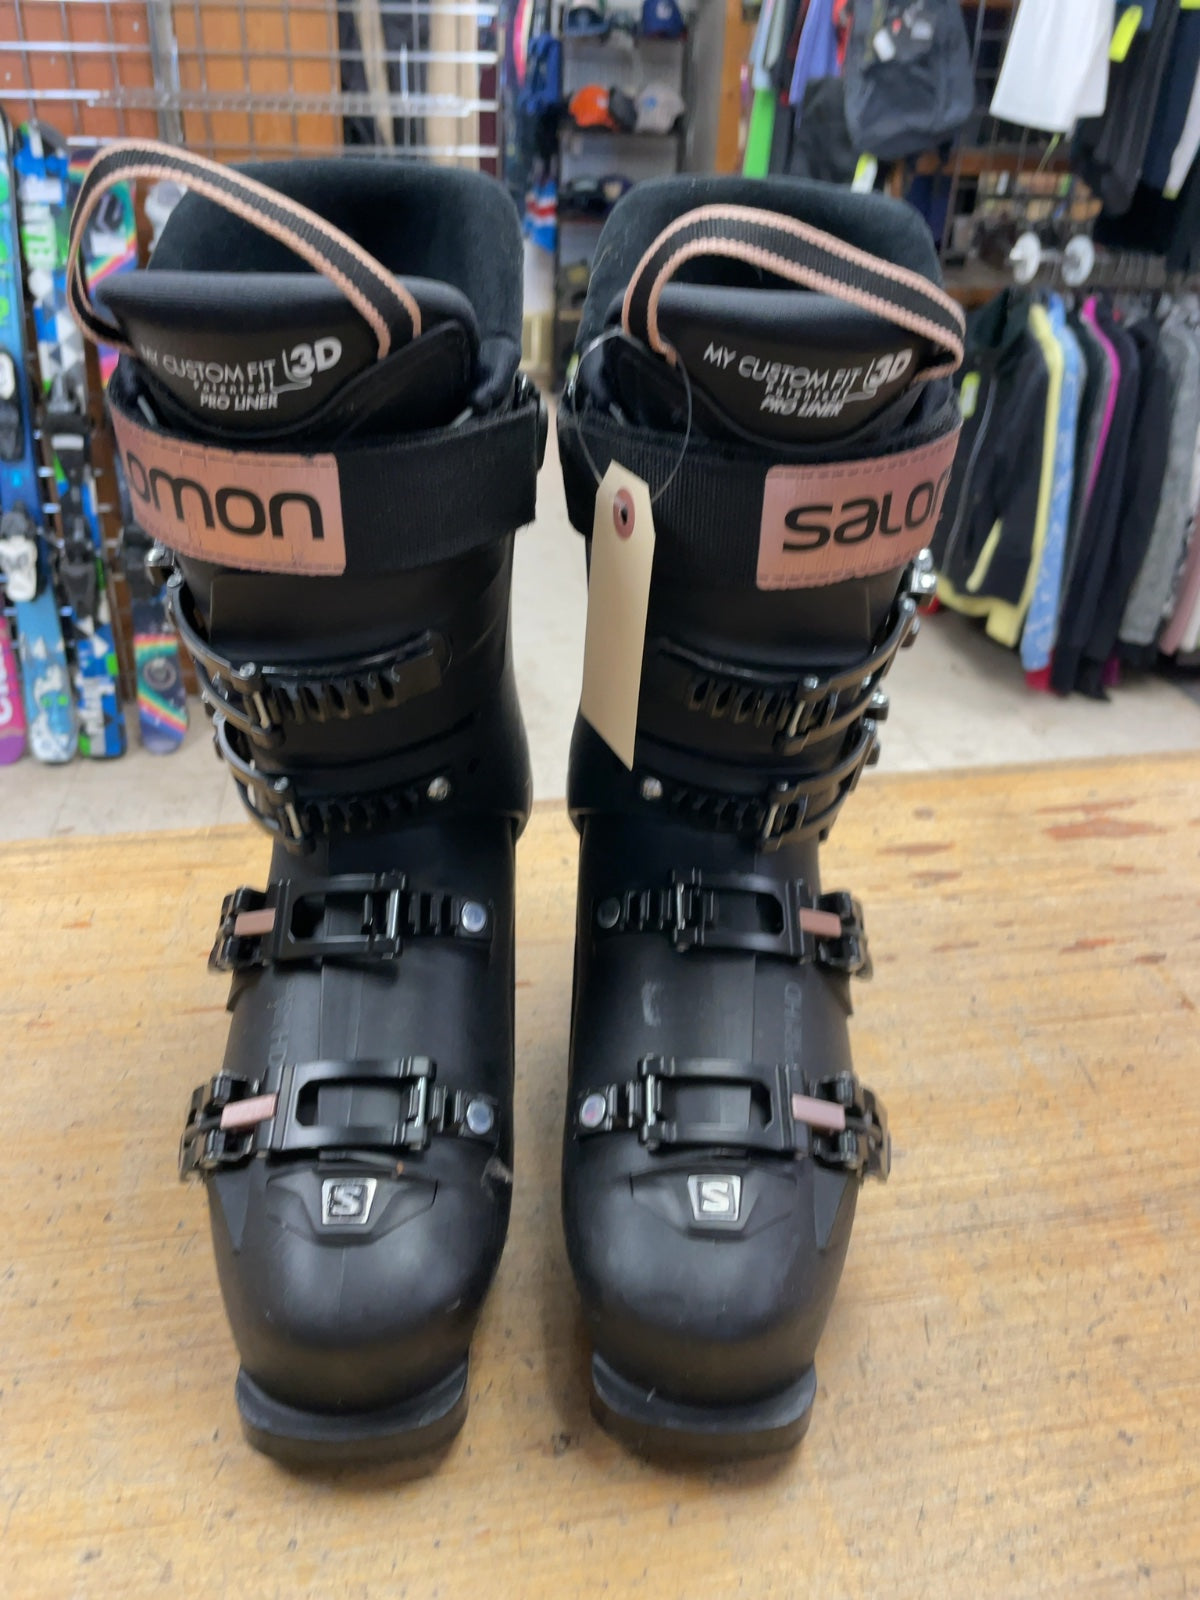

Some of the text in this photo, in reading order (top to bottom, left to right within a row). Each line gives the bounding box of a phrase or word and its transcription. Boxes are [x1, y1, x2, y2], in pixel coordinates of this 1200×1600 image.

[162, 354, 244, 384] CUSTOM
[247, 359, 277, 387] FIT
[290, 336, 343, 378] 3D
[703, 341, 913, 391] MY CUSTOM FIT 3D
[200, 392, 279, 411] PRO LINER
